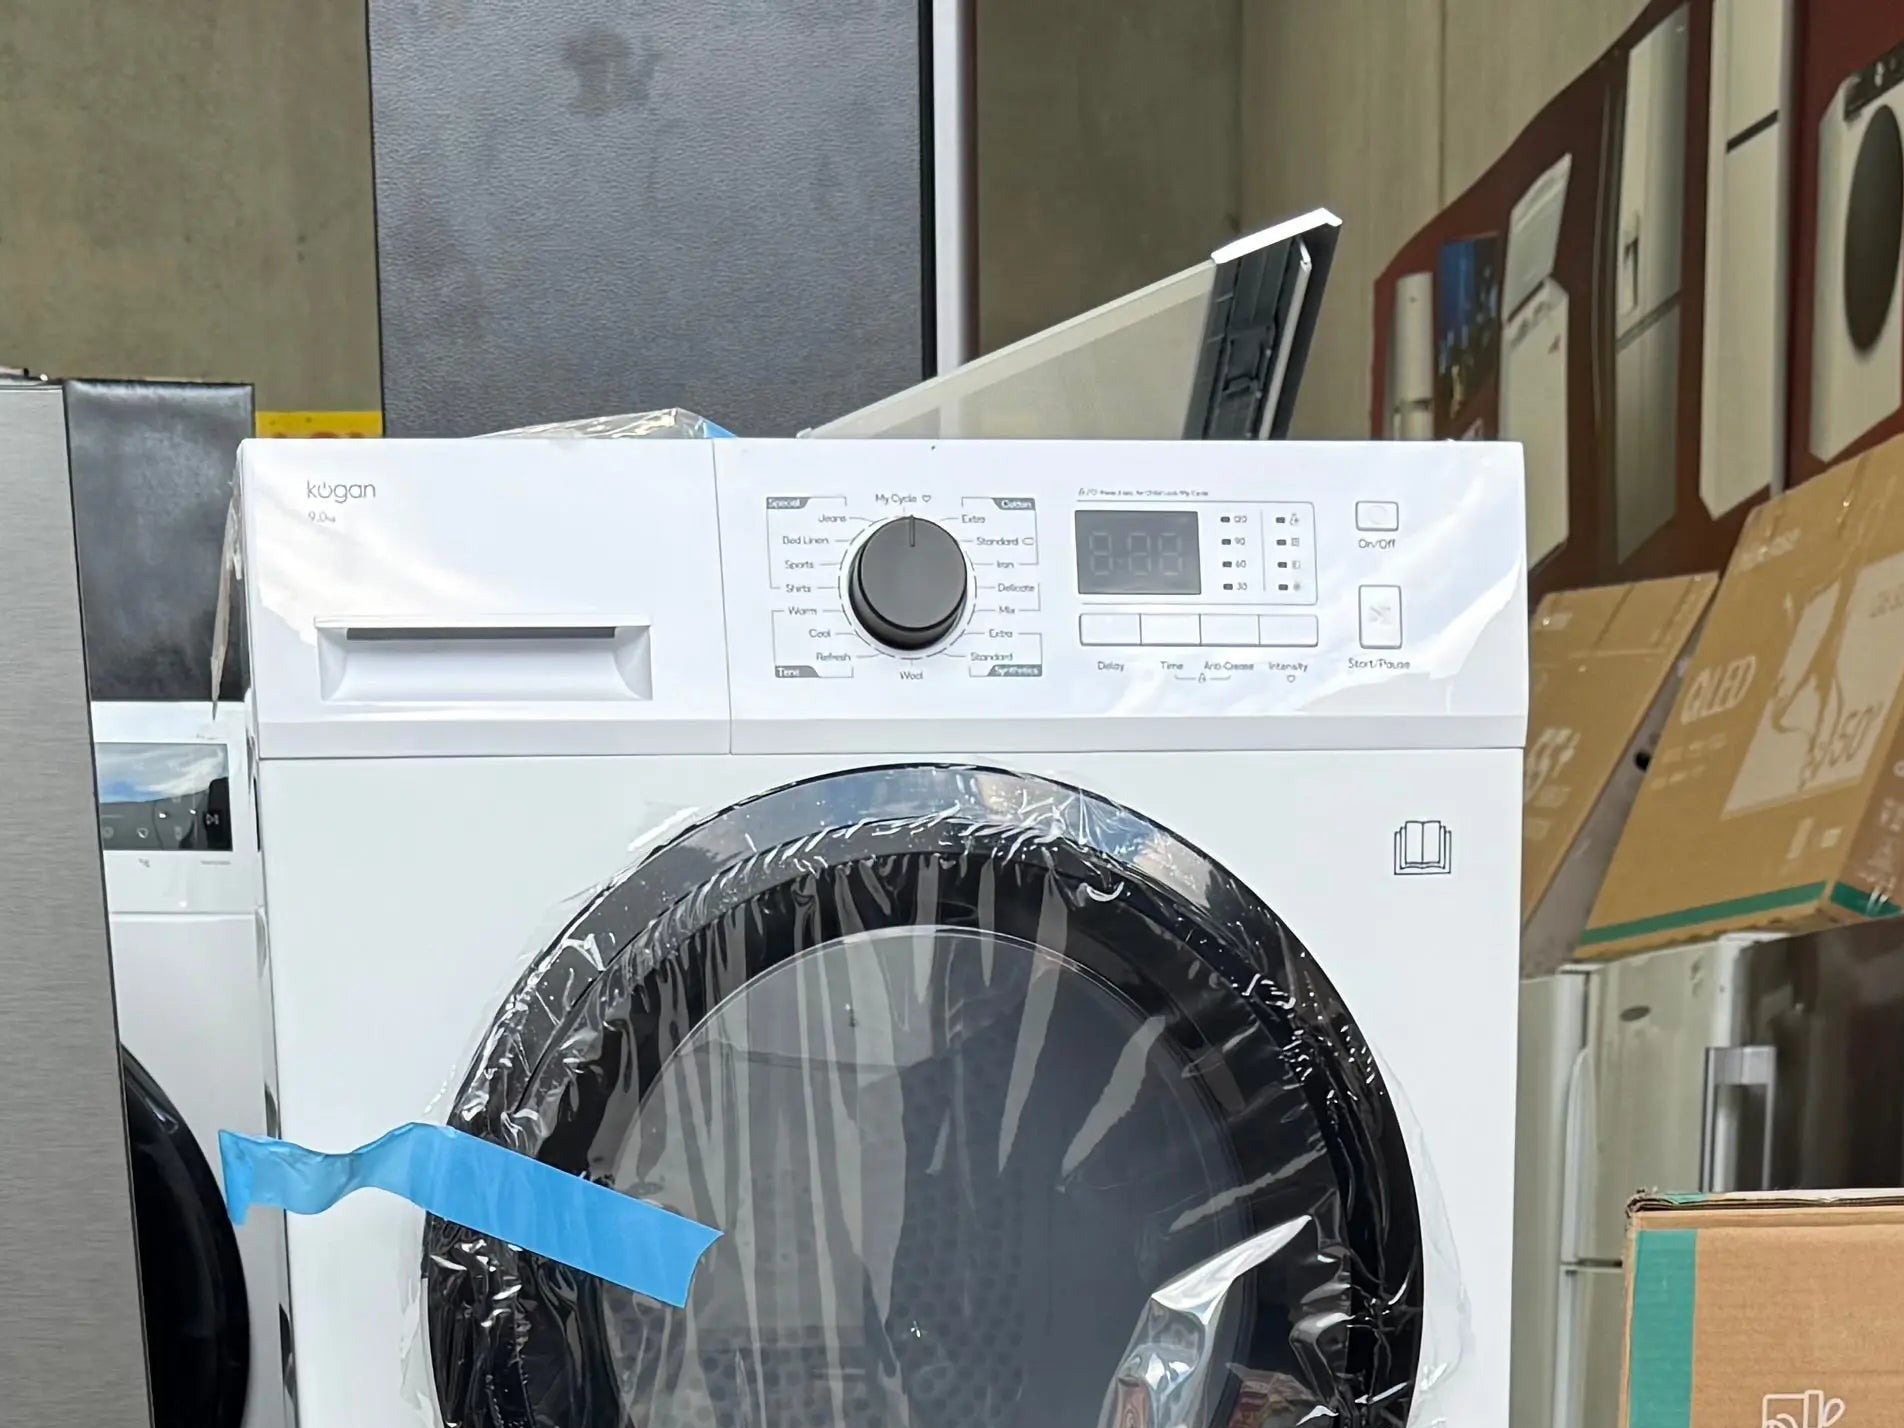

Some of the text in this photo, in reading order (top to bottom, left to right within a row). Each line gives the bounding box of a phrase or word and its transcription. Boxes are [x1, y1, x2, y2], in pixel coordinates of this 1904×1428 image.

[306, 480, 376, 504] kogan
[1358, 538, 1396, 550] On/Off
[808, 629, 831, 639] Cool
[1097, 661, 1125, 673] Delay
[899, 671, 924, 681] Wool
